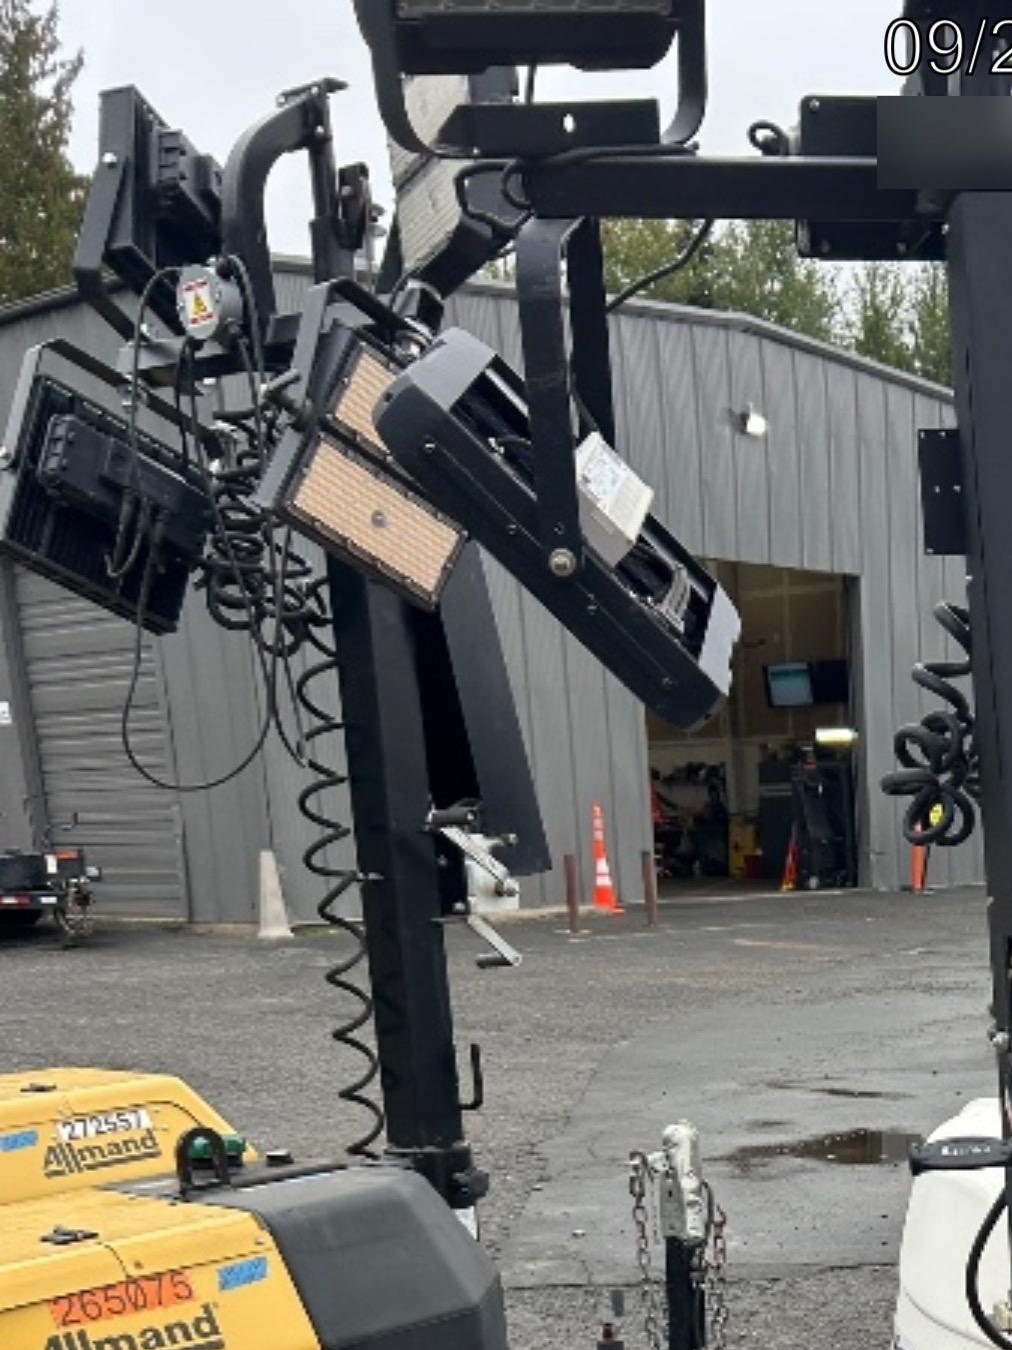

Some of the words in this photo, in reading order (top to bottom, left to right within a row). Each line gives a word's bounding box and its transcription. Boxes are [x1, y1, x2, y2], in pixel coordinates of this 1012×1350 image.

[61, 1110, 141, 1140] 272557
[43, 1127, 160, 1176] Allmand
[53, 1271, 194, 1327] 265075
